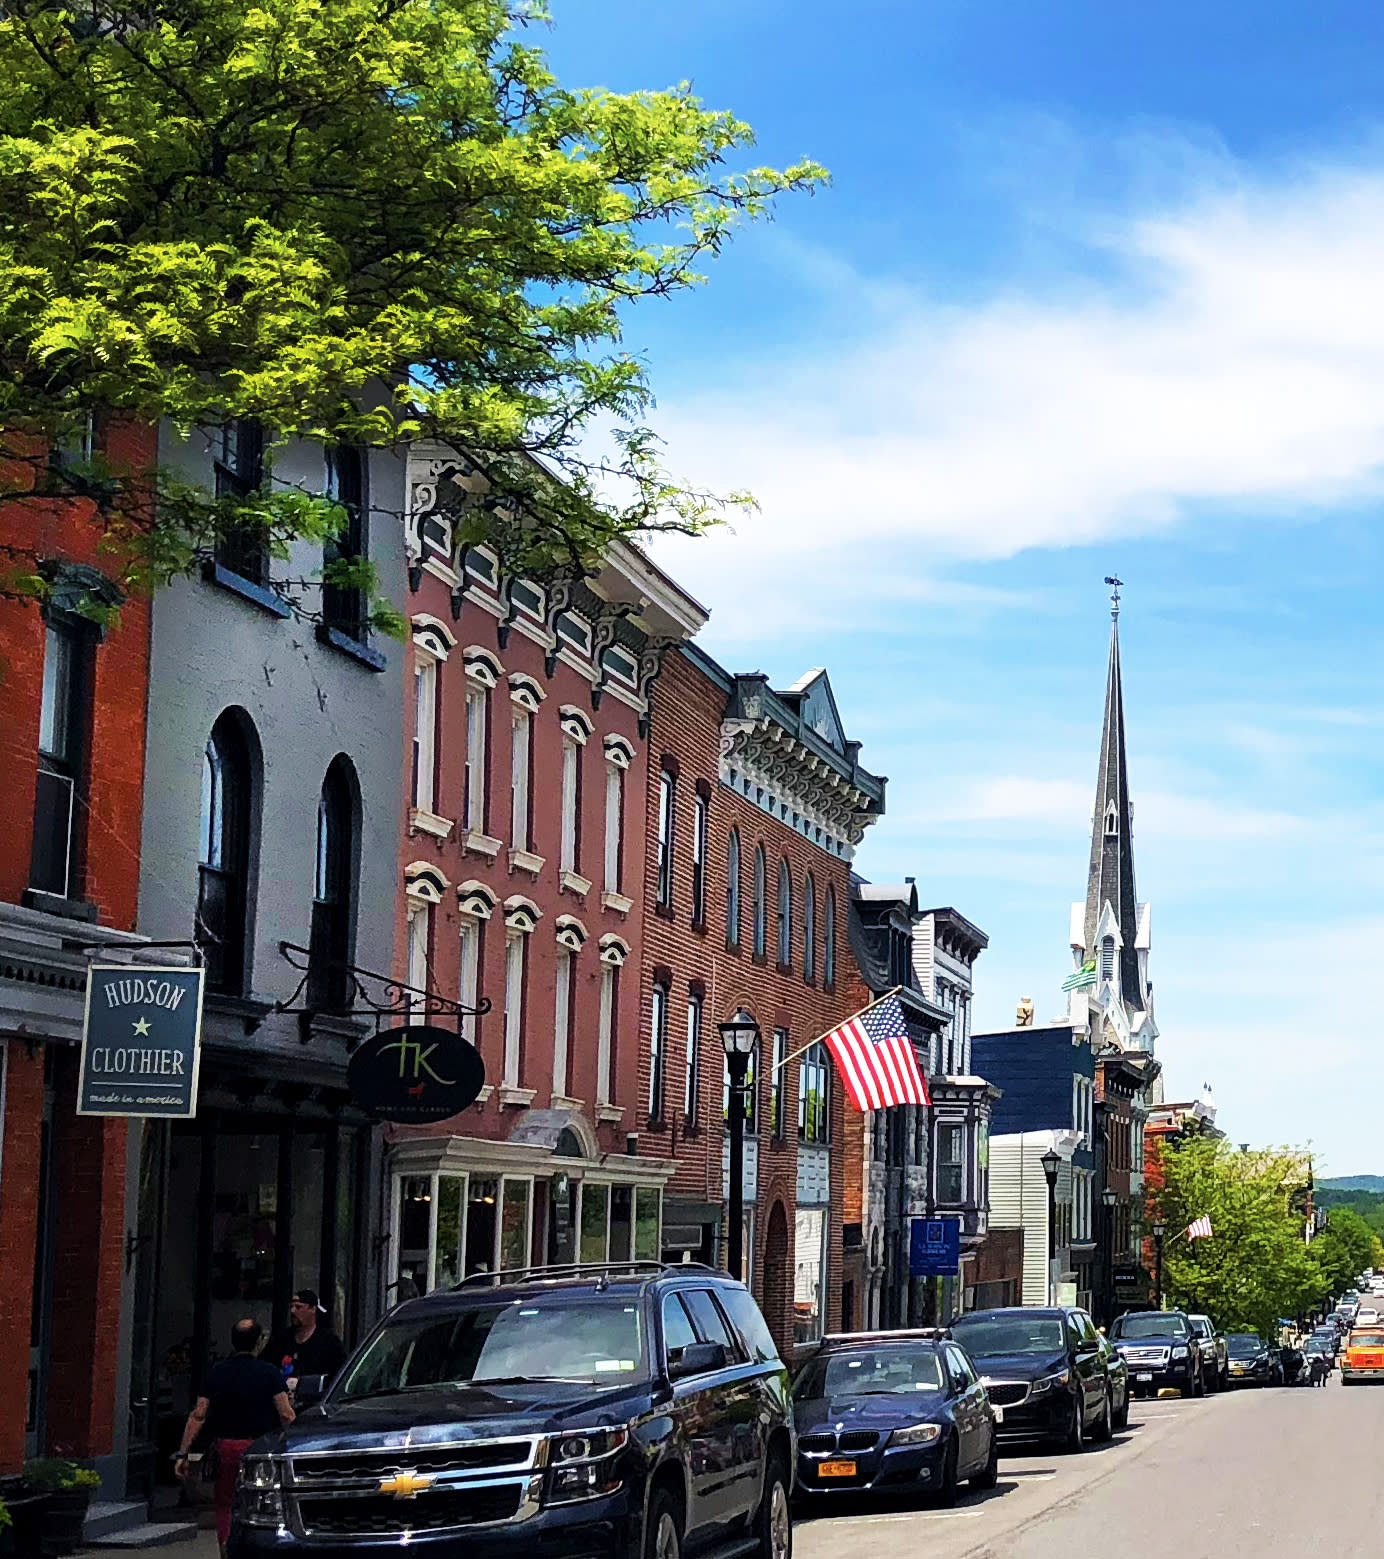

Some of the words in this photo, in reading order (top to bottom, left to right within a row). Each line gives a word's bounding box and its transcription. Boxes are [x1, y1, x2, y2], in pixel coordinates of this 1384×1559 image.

[104, 979, 186, 1011] HUDSON
[91, 1047, 185, 1075] CLOTHIER
[90, 1092, 119, 1103] made
[121, 1094, 135, 1103] in
[136, 1095, 184, 1105] america
